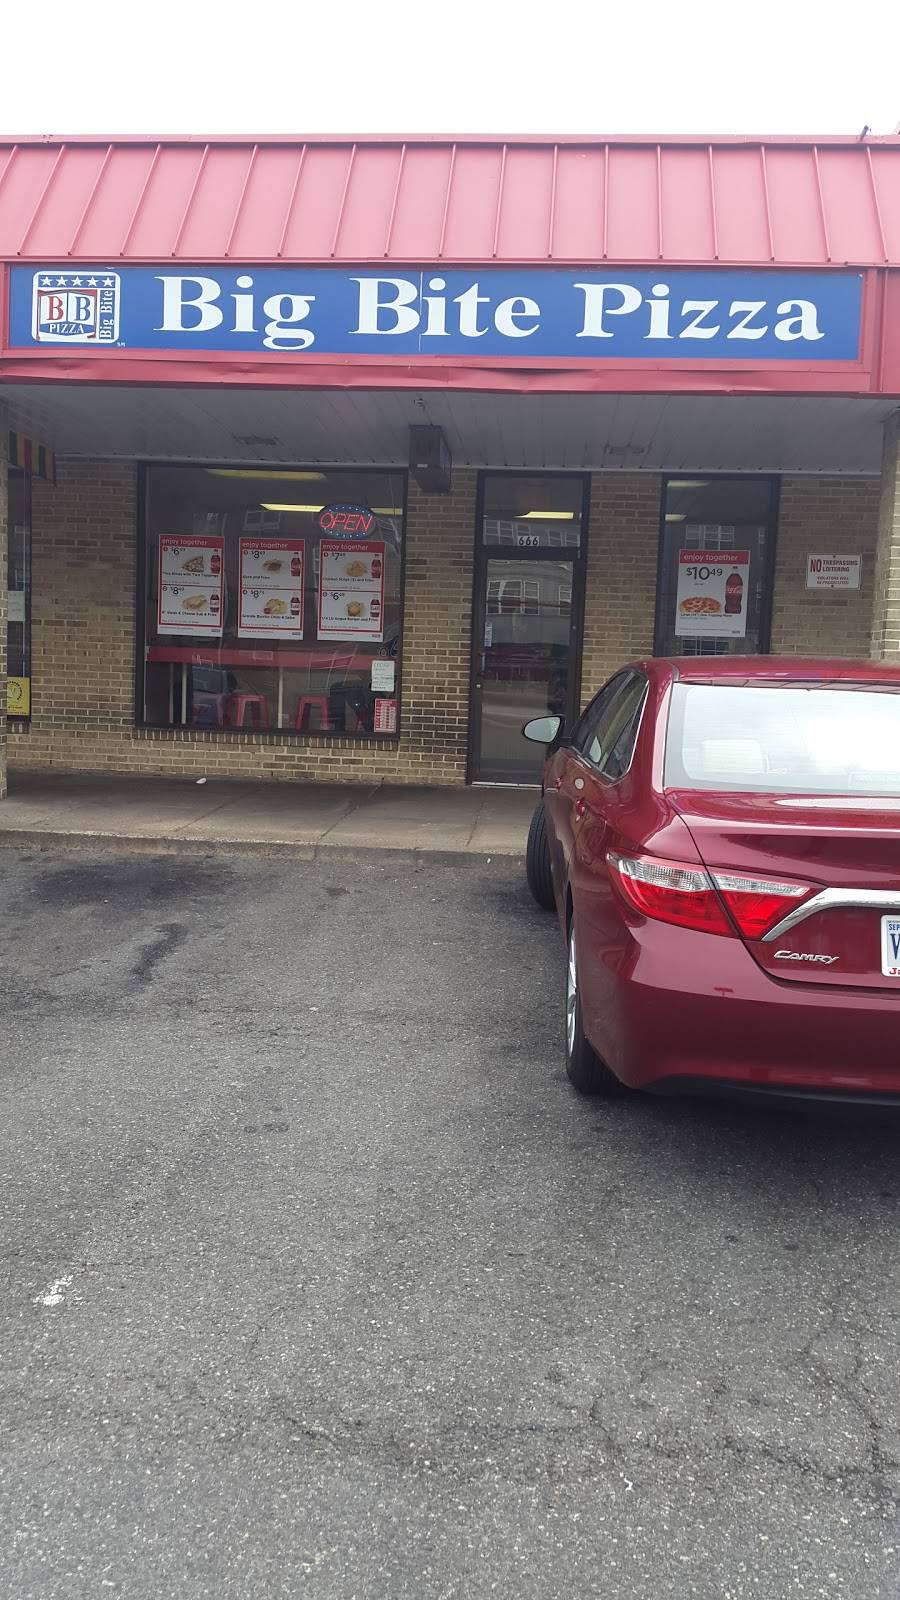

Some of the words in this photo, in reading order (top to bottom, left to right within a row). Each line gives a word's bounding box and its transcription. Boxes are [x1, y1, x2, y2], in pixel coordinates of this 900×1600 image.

[100, 290, 113, 313] Bite
[46, 296, 64, 321] B
[74, 296, 91, 321] B
[153, 275, 316, 350] Big
[348, 277, 541, 338] Bite
[573, 283, 825, 341] Pizza
[49, 323, 84, 334] PIZZA
[100, 320, 114, 339] Big
[320, 512, 373, 531] OPEN
[162, 538, 179, 546] enjoy
[180, 538, 207, 547] together
[242, 541, 260, 549] enjoy
[322, 543, 340, 551] enjoy
[340, 543, 369, 551] together
[518, 536, 539, 546] 666
[683, 553, 704, 562] enjoy
[705, 553, 738, 562] together
[810, 559, 822, 572] NO
